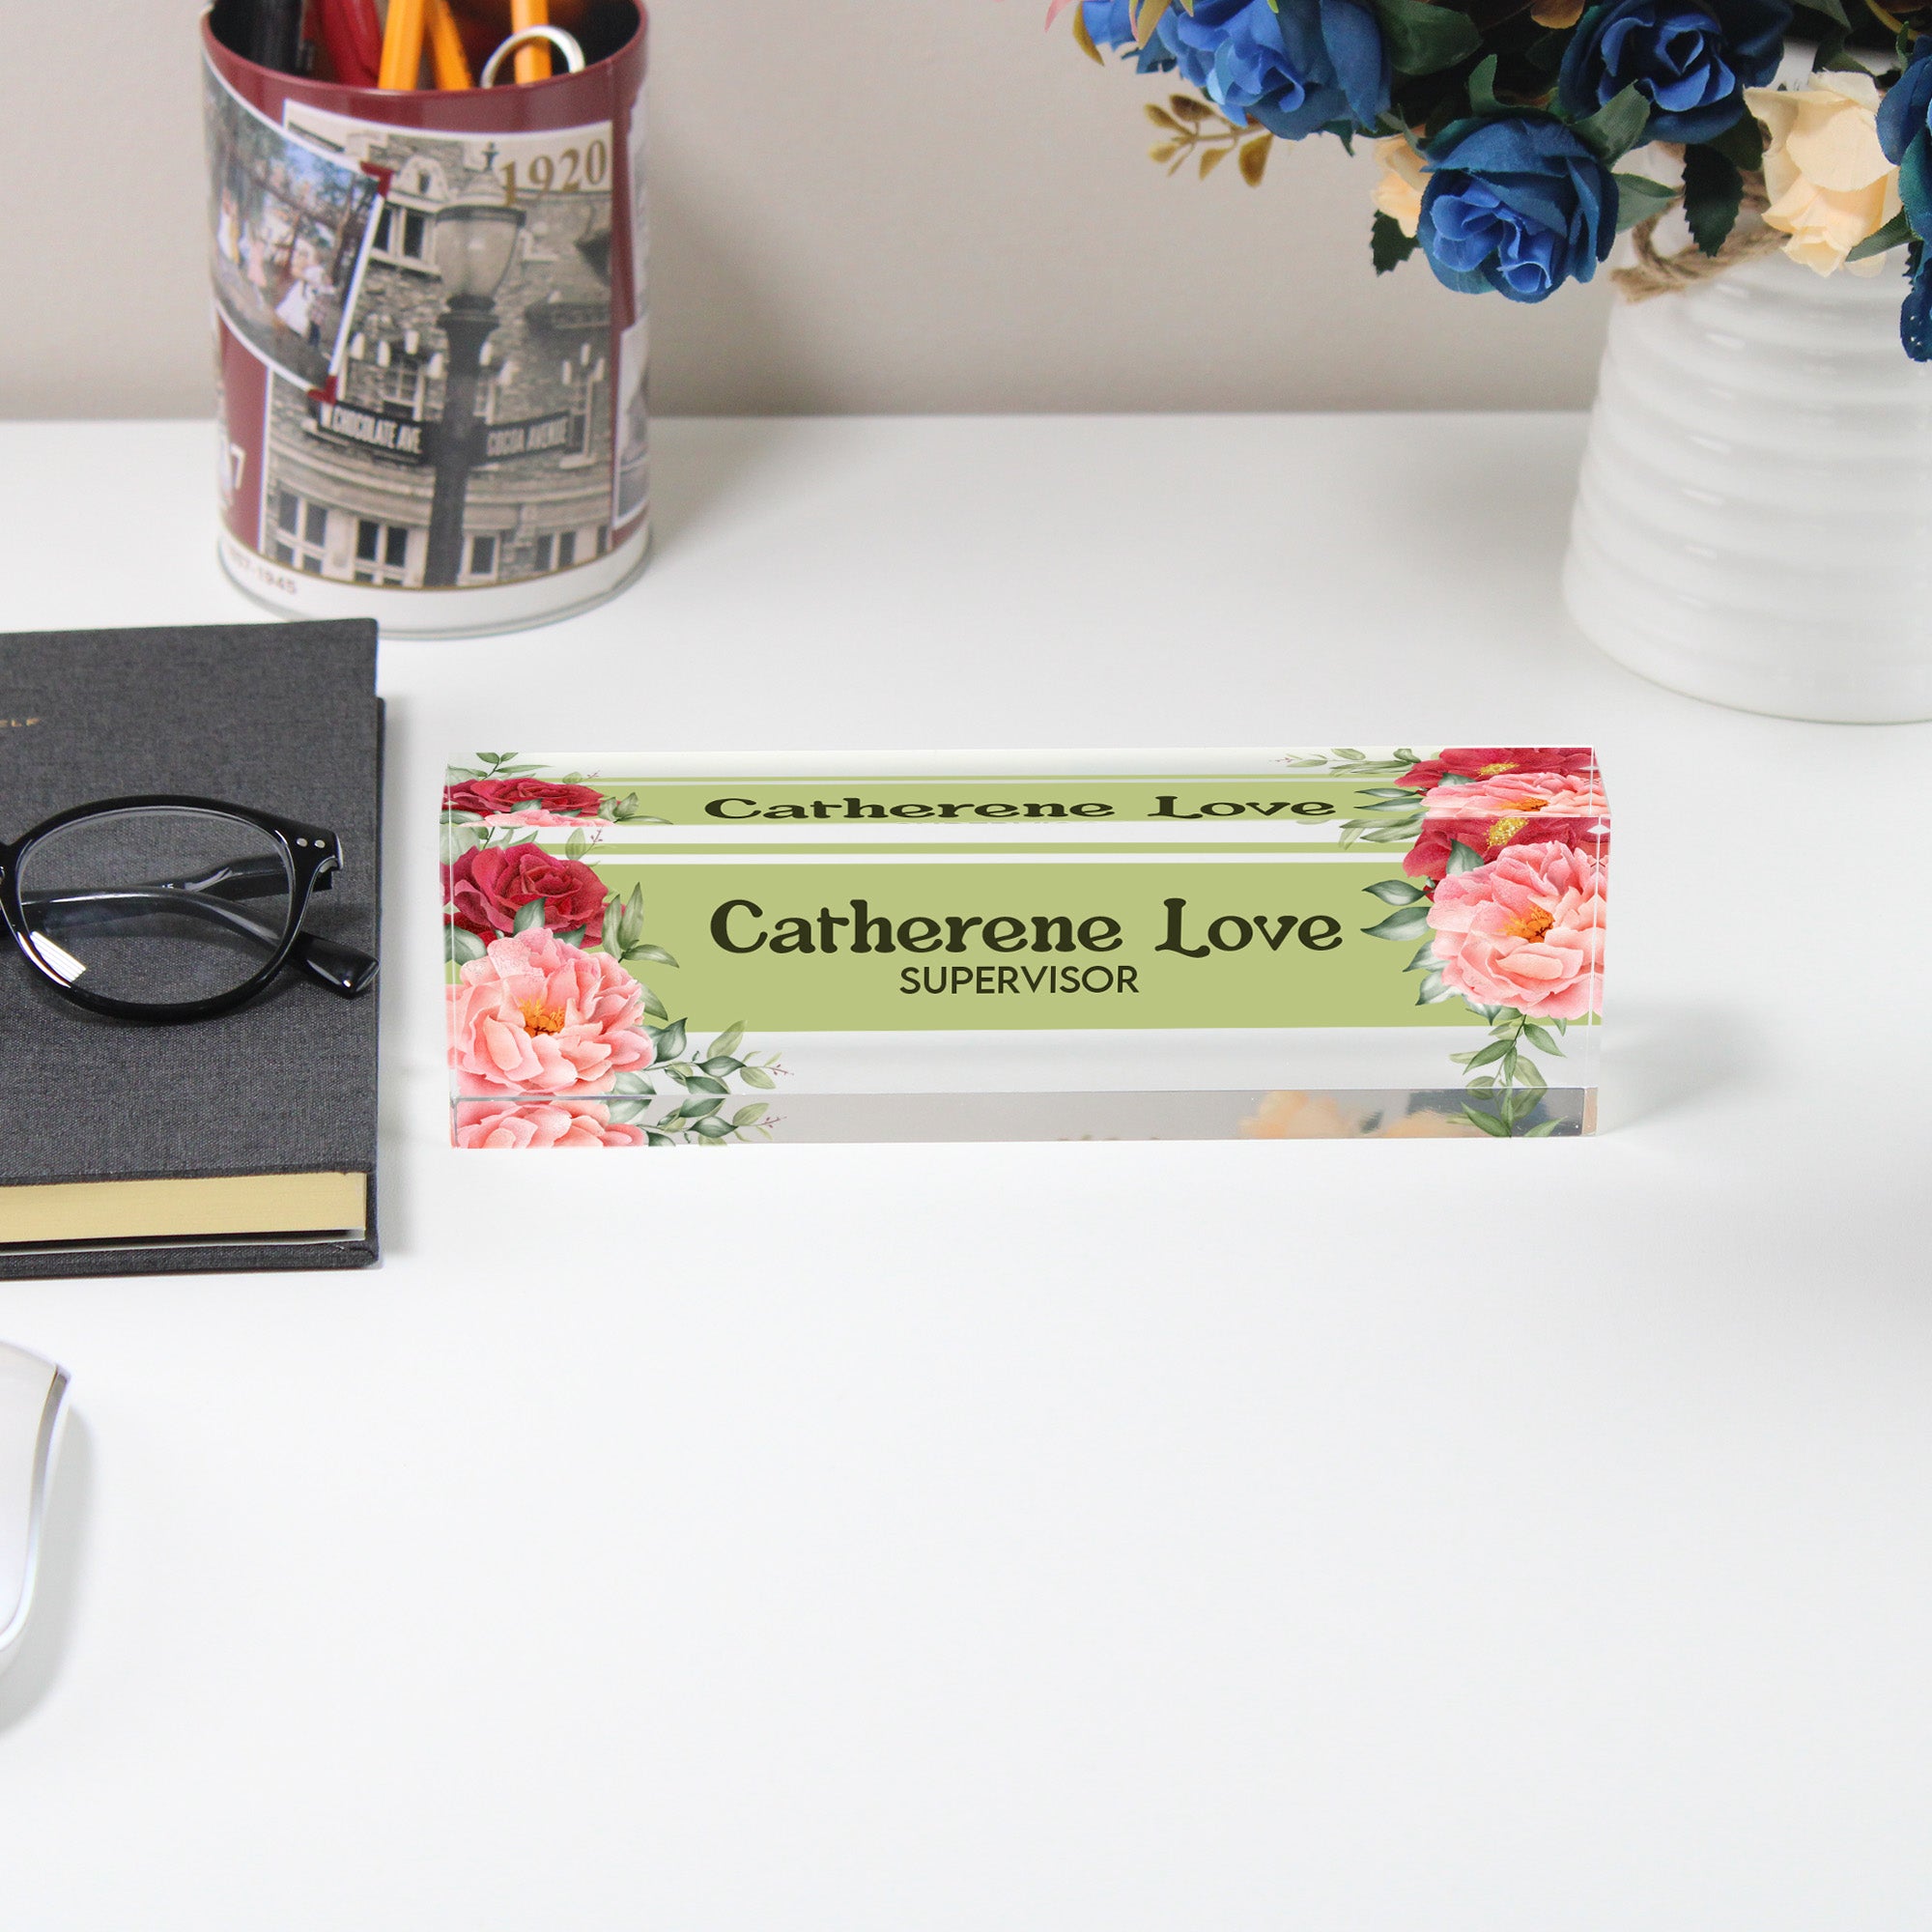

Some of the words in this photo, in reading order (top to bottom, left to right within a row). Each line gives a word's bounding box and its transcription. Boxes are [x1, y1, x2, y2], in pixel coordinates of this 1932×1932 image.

[500, 139, 607, 207] 1920
[705, 797, 1116, 819] Catherene
[1147, 795, 1336, 820] Love
[710, 898, 1123, 954] Catherene
[1154, 897, 1343, 959] Love
[899, 965, 1140, 995] SUPERVISOR
